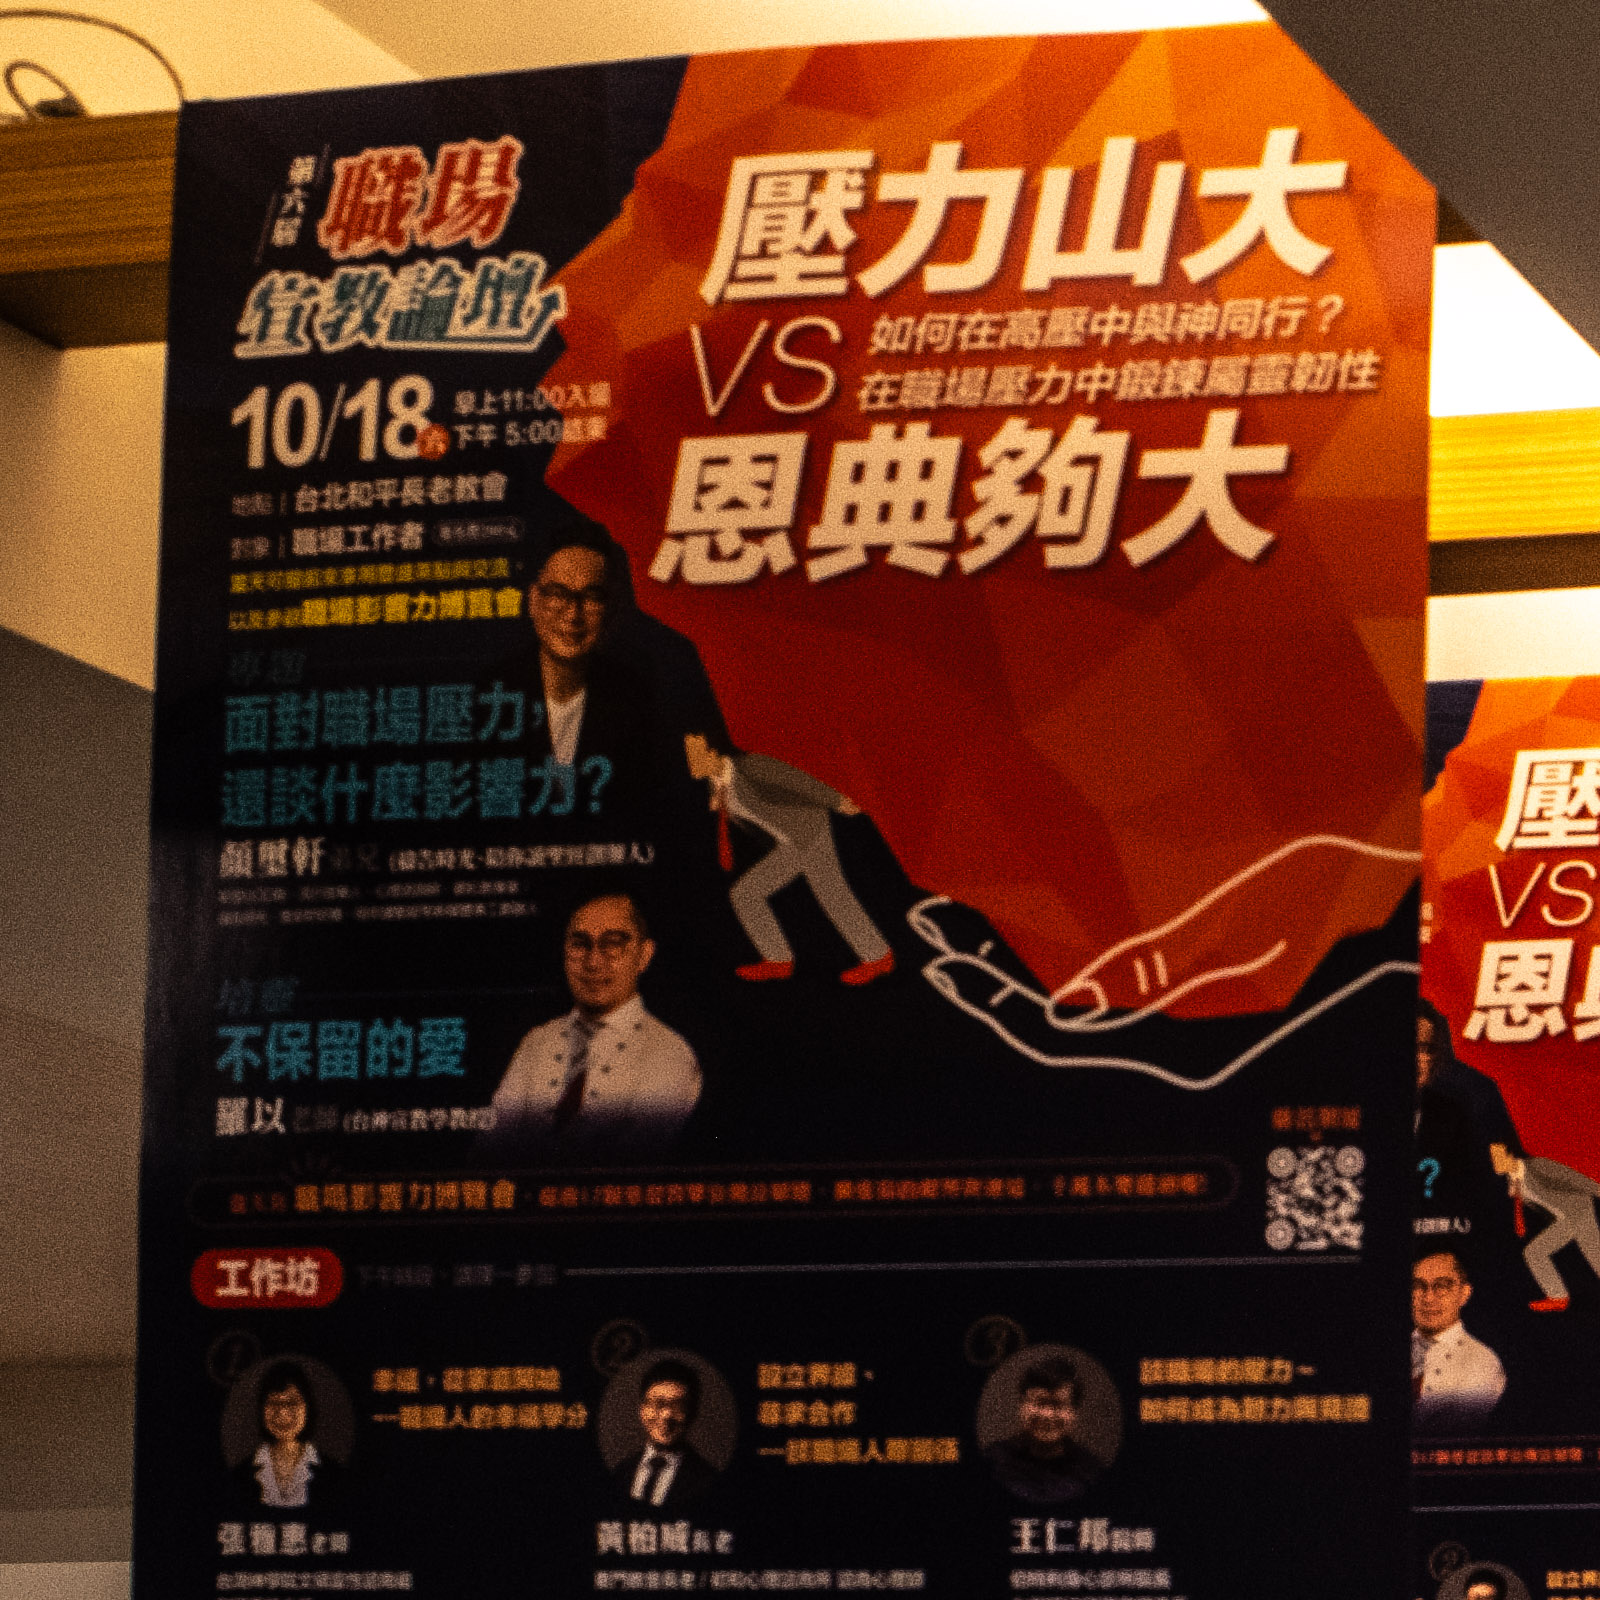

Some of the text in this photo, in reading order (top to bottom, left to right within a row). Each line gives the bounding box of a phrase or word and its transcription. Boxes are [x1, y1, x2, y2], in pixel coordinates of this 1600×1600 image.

[318, 135, 525, 260] 職場
[698, 126, 1349, 307] 壓力山大
[688, 316, 843, 418] VS
[868, 293, 1343, 356] 如何在高壓中與神同行？
[230, 374, 436, 470] 10/18
[648, 406, 1293, 588] 恩典夠大
[1487, 859, 1599, 930] VS
[216, 1017, 467, 1083] 不保留的愛
[214, 1257, 321, 1299] 工作坊
